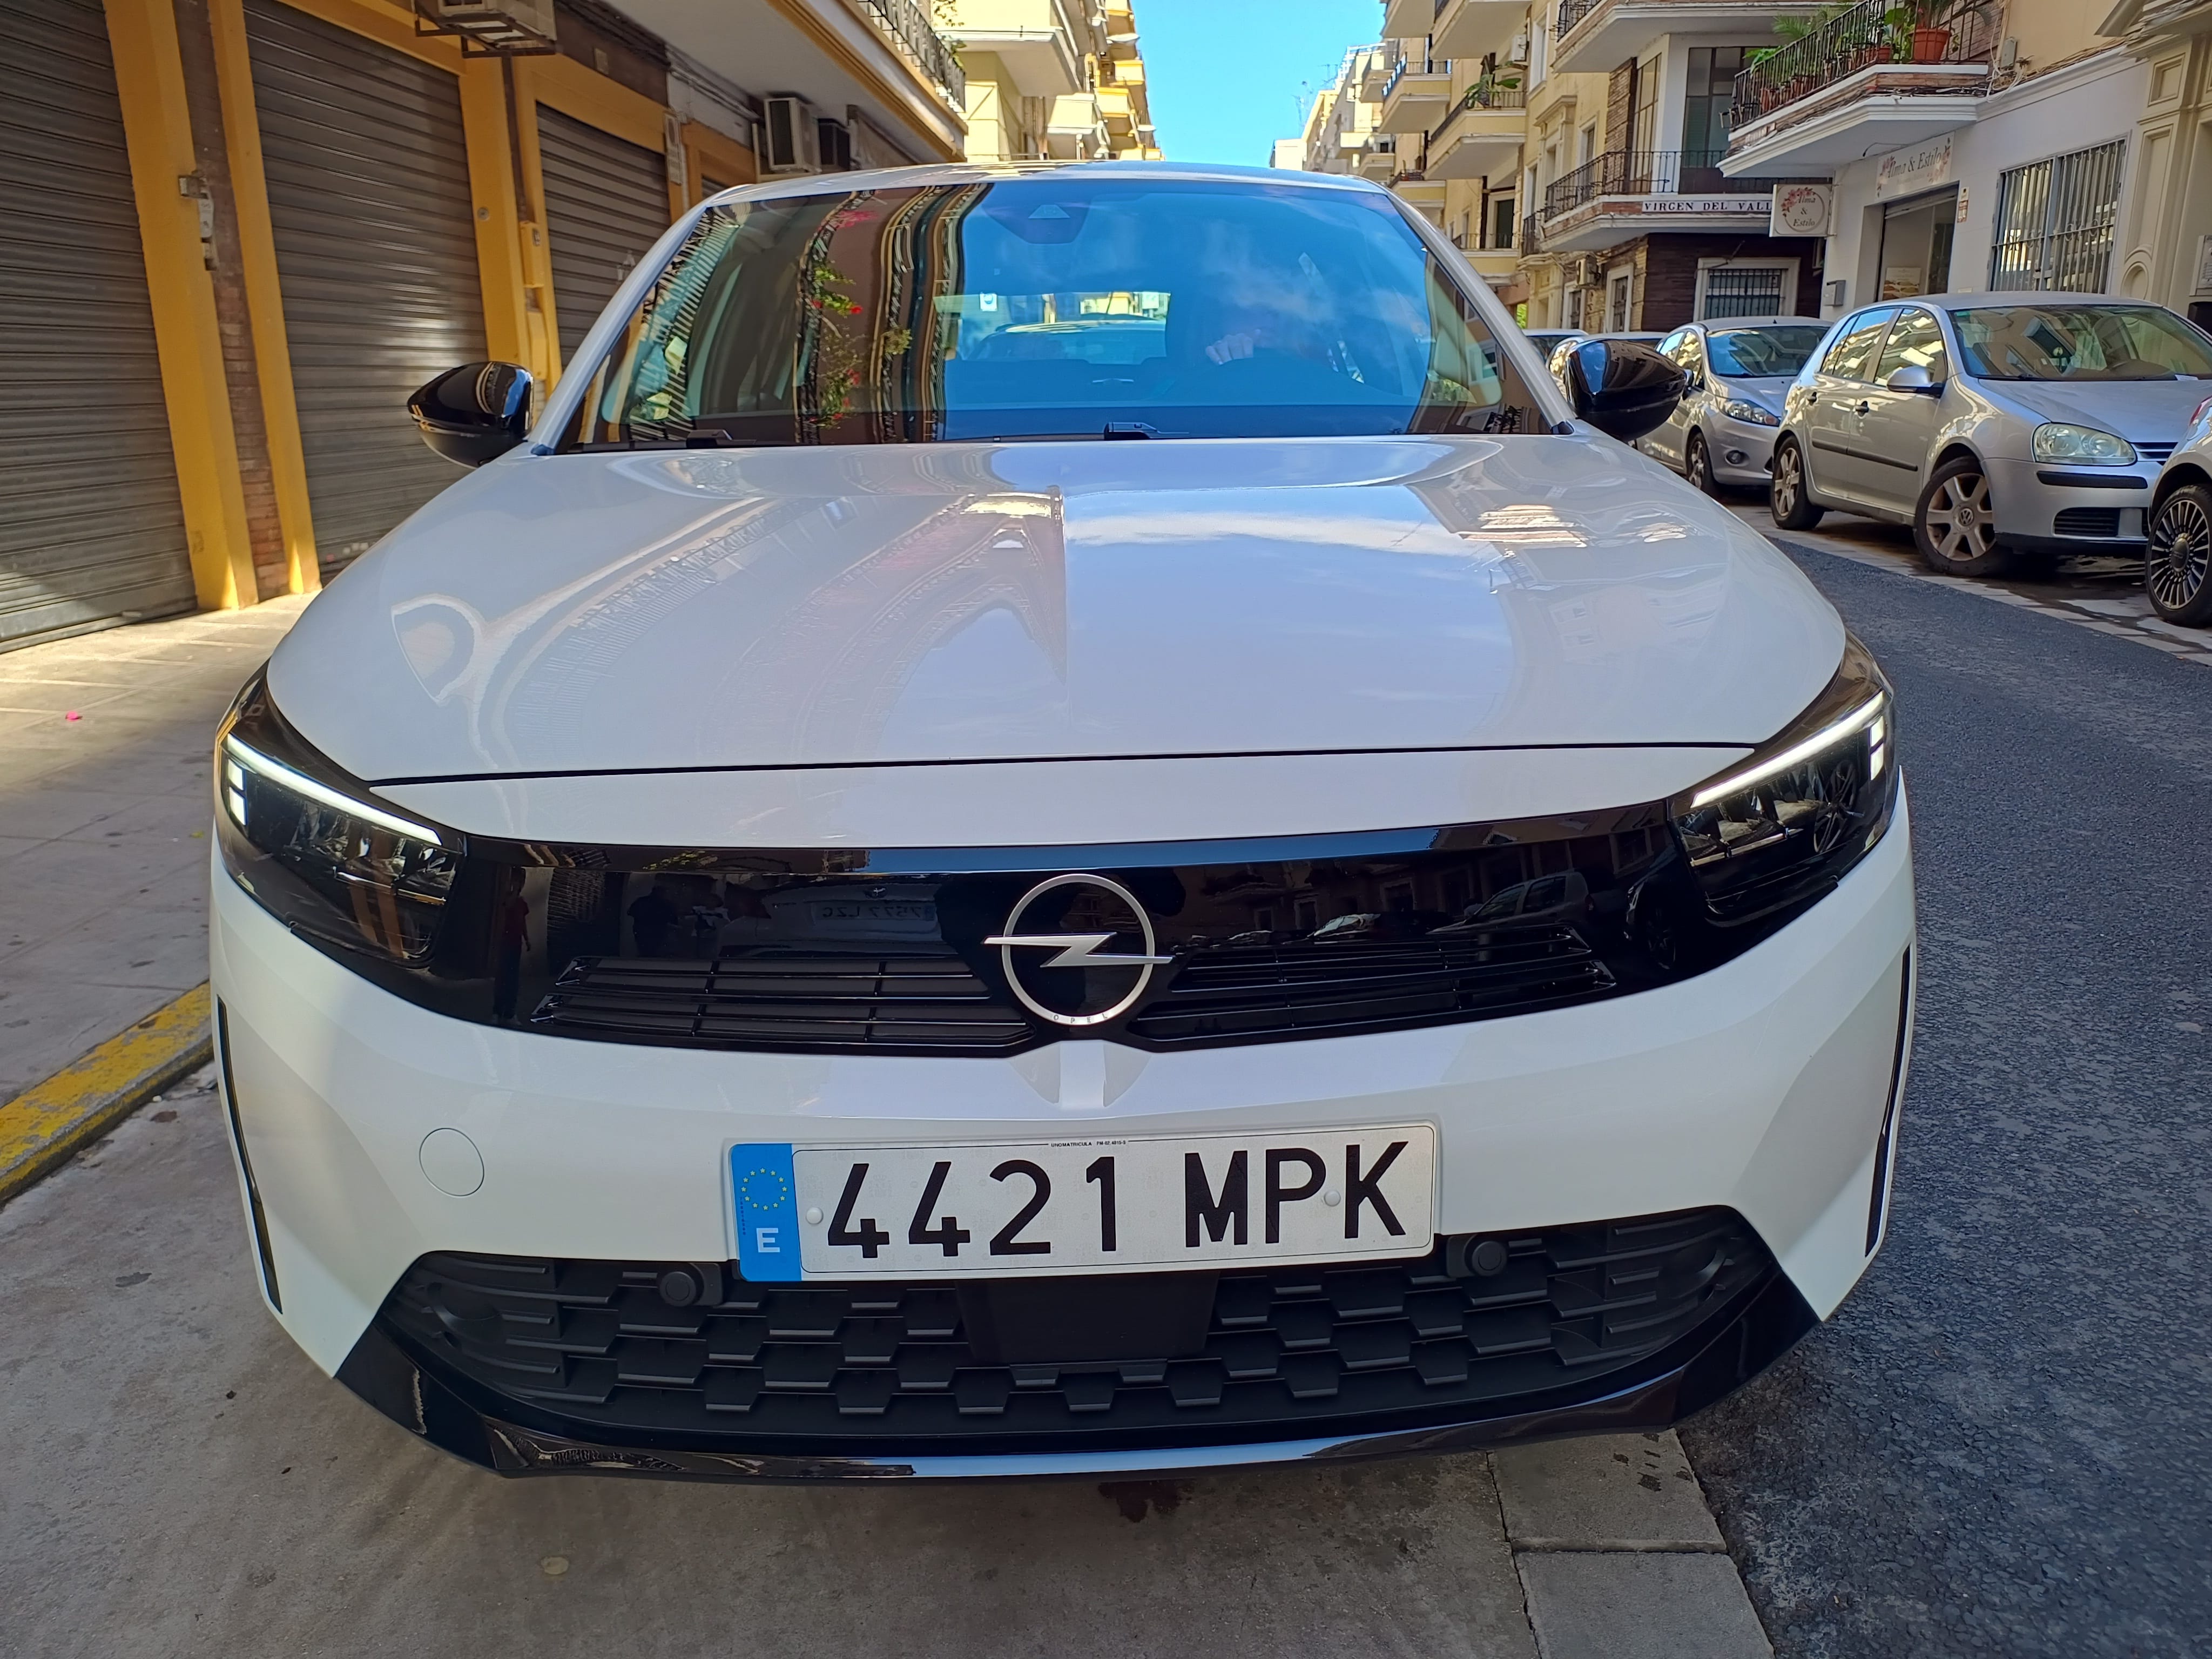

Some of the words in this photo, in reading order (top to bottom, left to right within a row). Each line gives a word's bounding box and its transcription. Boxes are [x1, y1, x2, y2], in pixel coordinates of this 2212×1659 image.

[1908, 157, 1915, 172] &
[1917, 147, 1941, 170] Estilo
[1644, 202, 1694, 211] VIRGEN
[1703, 202, 1728, 211] DEL
[1738, 201, 1772, 211] VALL
[1793, 218, 1816, 226] Estilo
[1053, 1013, 1108, 1024] OPEL
[828, 1157, 1116, 1259] 4421
[1185, 1141, 1409, 1248] MPK
[756, 1228, 780, 1253] E
